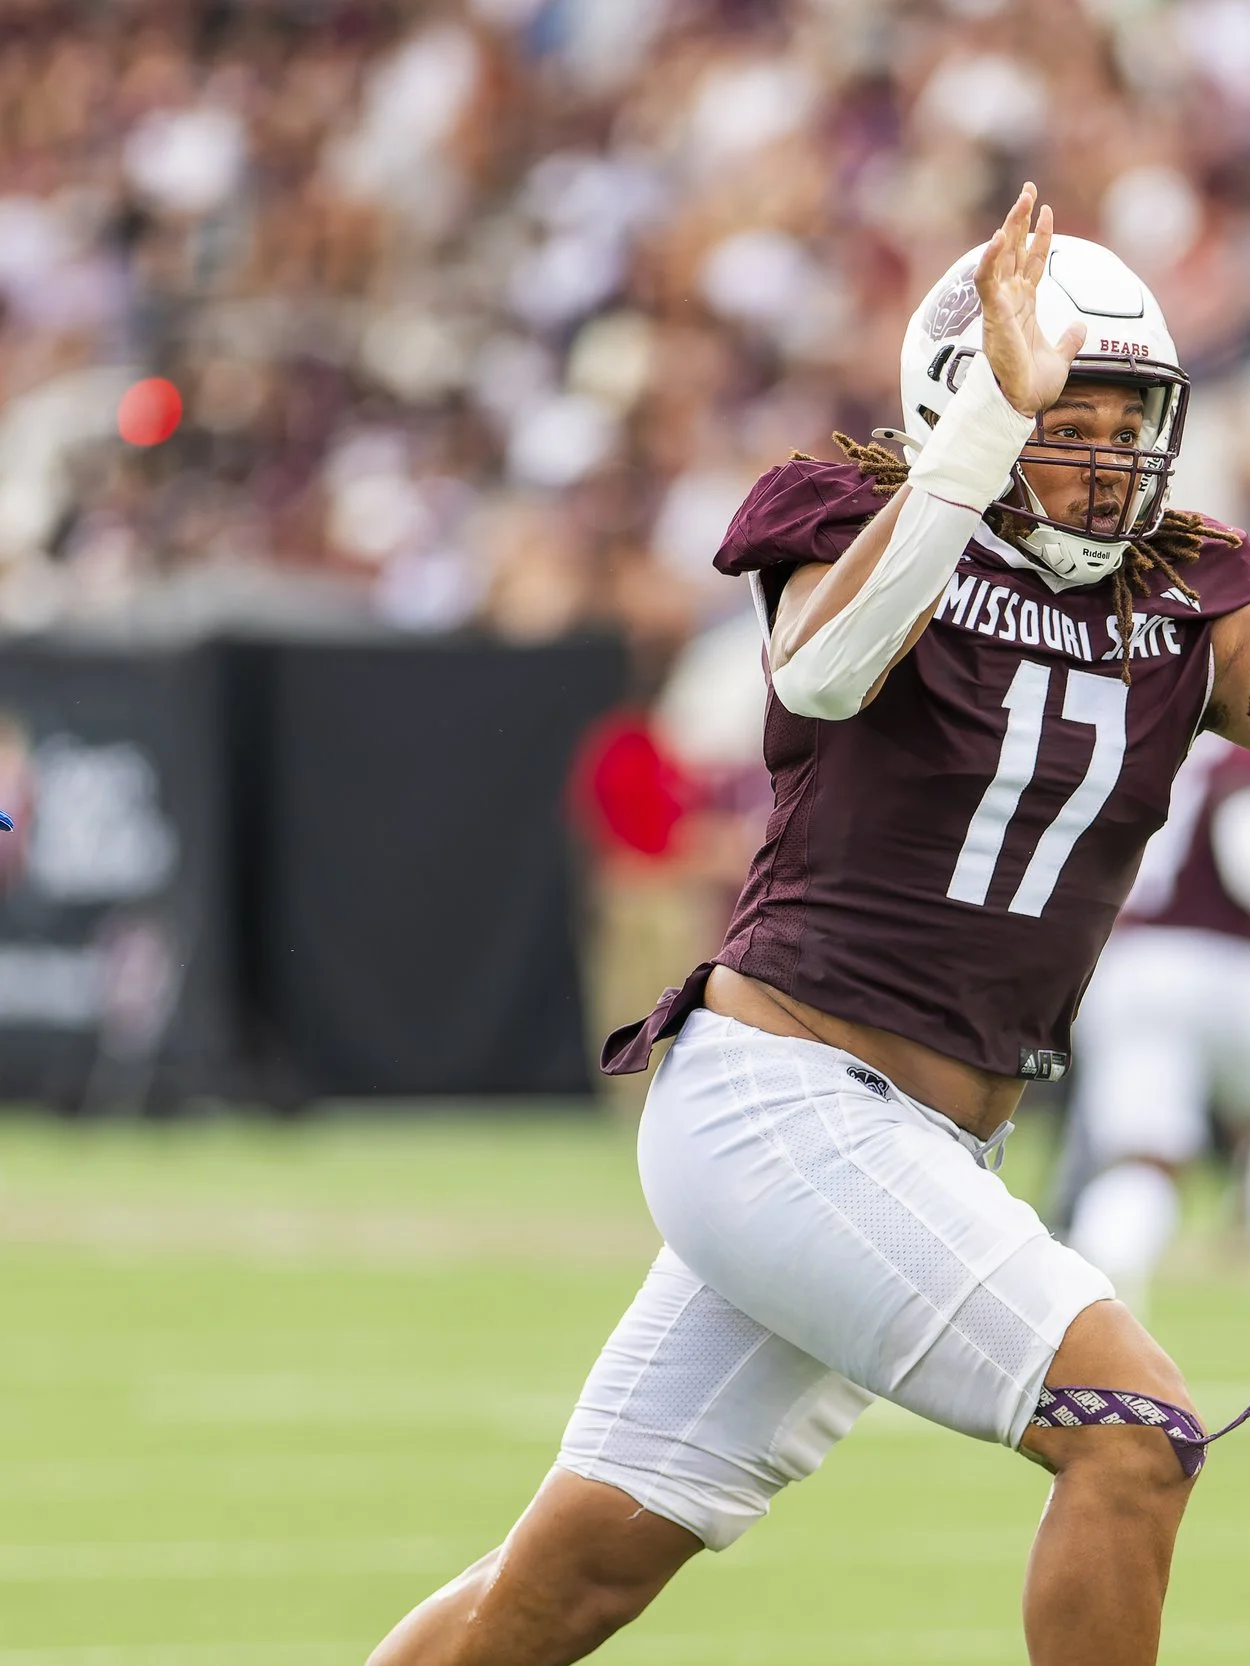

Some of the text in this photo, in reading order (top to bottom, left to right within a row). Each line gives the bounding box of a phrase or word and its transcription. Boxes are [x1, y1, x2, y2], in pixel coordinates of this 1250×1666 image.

[1100, 339, 1149, 357] BEARS
[1082, 547, 1111, 560] Riddell
[932, 571, 1093, 662] MISSOURI
[946, 658, 1130, 918] 17
